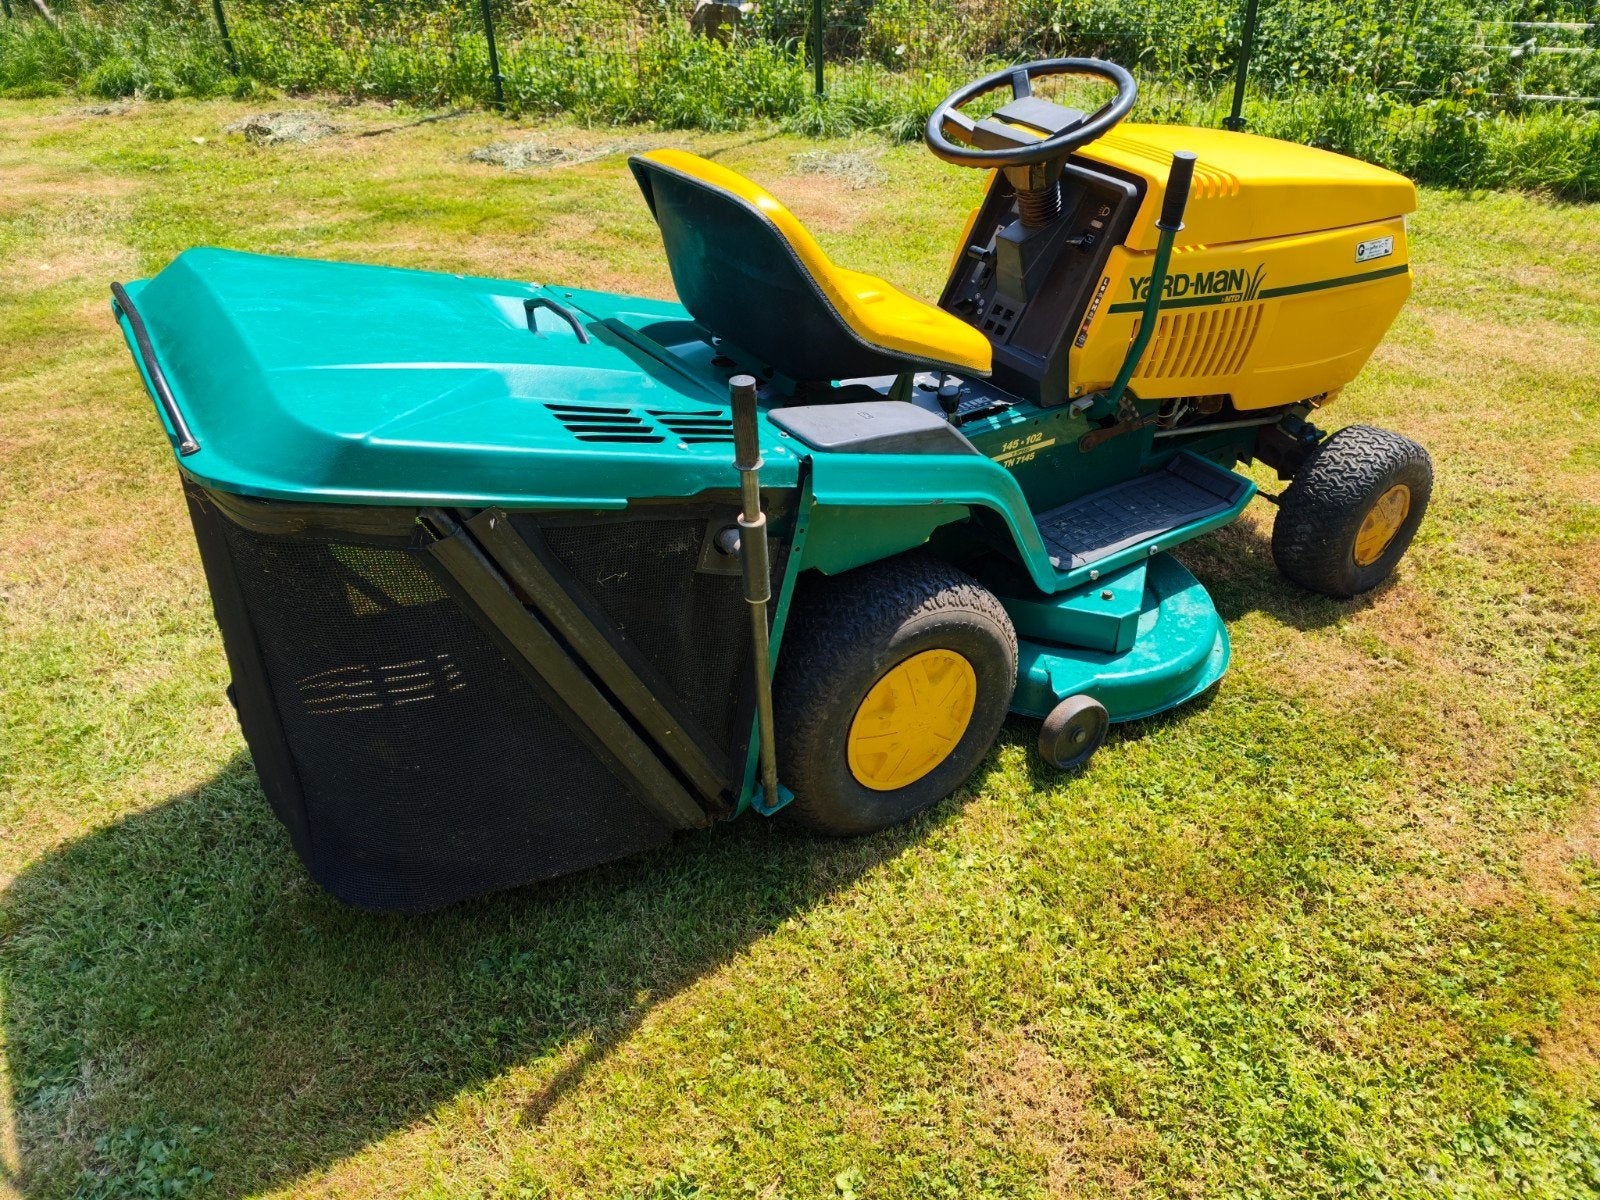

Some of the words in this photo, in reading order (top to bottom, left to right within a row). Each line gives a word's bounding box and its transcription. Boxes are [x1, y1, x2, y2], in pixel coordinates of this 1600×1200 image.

[1002, 439, 1020, 452] 145
[1026, 432, 1043, 445] 102
[1003, 458, 1015, 468] TN
[1016, 452, 1036, 464] 7145
